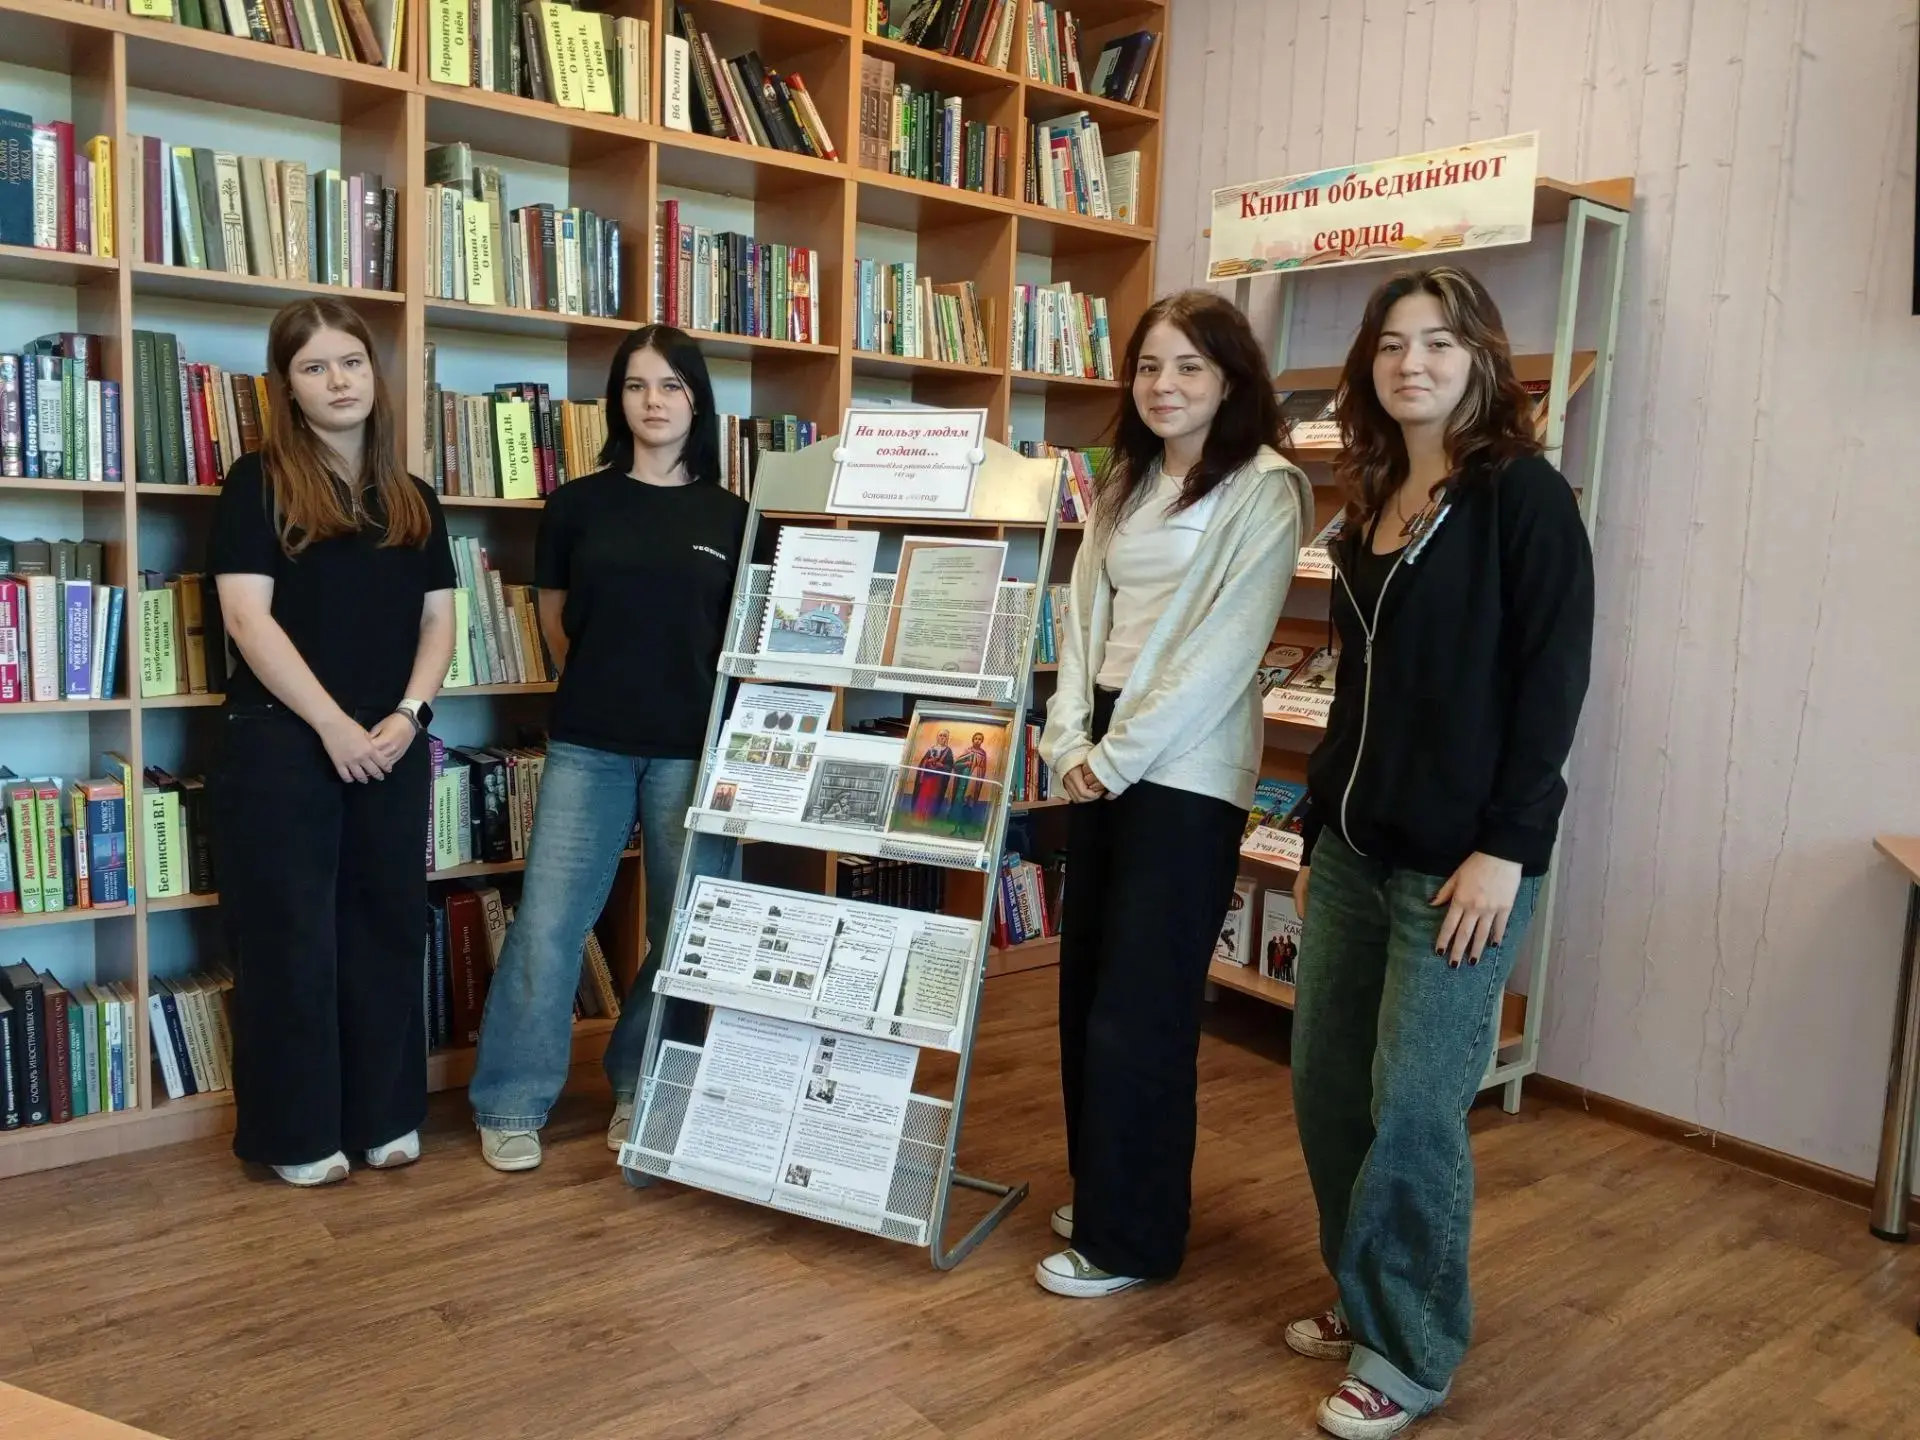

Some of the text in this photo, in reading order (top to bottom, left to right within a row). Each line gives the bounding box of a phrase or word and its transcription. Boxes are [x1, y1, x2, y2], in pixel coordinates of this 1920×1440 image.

[441, 8, 452, 77] Лермонтов
[454, 11, 464, 34] нём
[549, 5, 570, 101] Маяковский В.
[566, 37, 577, 61] нём
[583, 39, 596, 93] Некрасов
[592, 41, 603, 65] нём
[671, 49, 682, 120] 86 Религия
[0, 139, 8, 181] СЛОВАРЬ
[9, 138, 20, 185] РУССКОГО
[21, 149, 31, 180] ЯЗЫКА
[1240, 152, 1507, 219] Книги объединяют
[469, 214, 482, 286] Пушкин А.С.
[479, 234, 490, 257] нём
[1313, 219, 1404, 256] сердца
[25, 414, 37, 458] Словарь
[503, 414, 518, 484] Толстой Л.Н.
[518, 432, 529, 454] нём
[856, 425, 969, 440] На пользу людям
[1308, 423, 1332, 431] Книг
[876, 446, 939, 458] создана...
[1304, 550, 1328, 558] Книг
[492, 577, 504, 611] ЧЕХОВА
[73, 601, 82, 671] РУССКОГО ЯЗЫКА
[143, 600, 152, 654] литература
[153, 626, 163, 682] зарубежных
[1281, 692, 1310, 702] Книги
[445, 786, 453, 855] Искусствознание
[459, 770, 469, 829] АФОРИЗМОВ
[20, 803, 35, 879] Английский язык
[43, 803, 58, 879] Английский язык
[152, 796, 170, 893] Белинский В.Г.
[1266, 831, 1298, 847] Книги,
[487, 899, 501, 931] 500
[1020, 892, 1034, 935] БОЛЬШАЯ
[25, 989, 40, 1104] СЛОВАРЬ ИНОСТРАННЫХ СЛОВ
